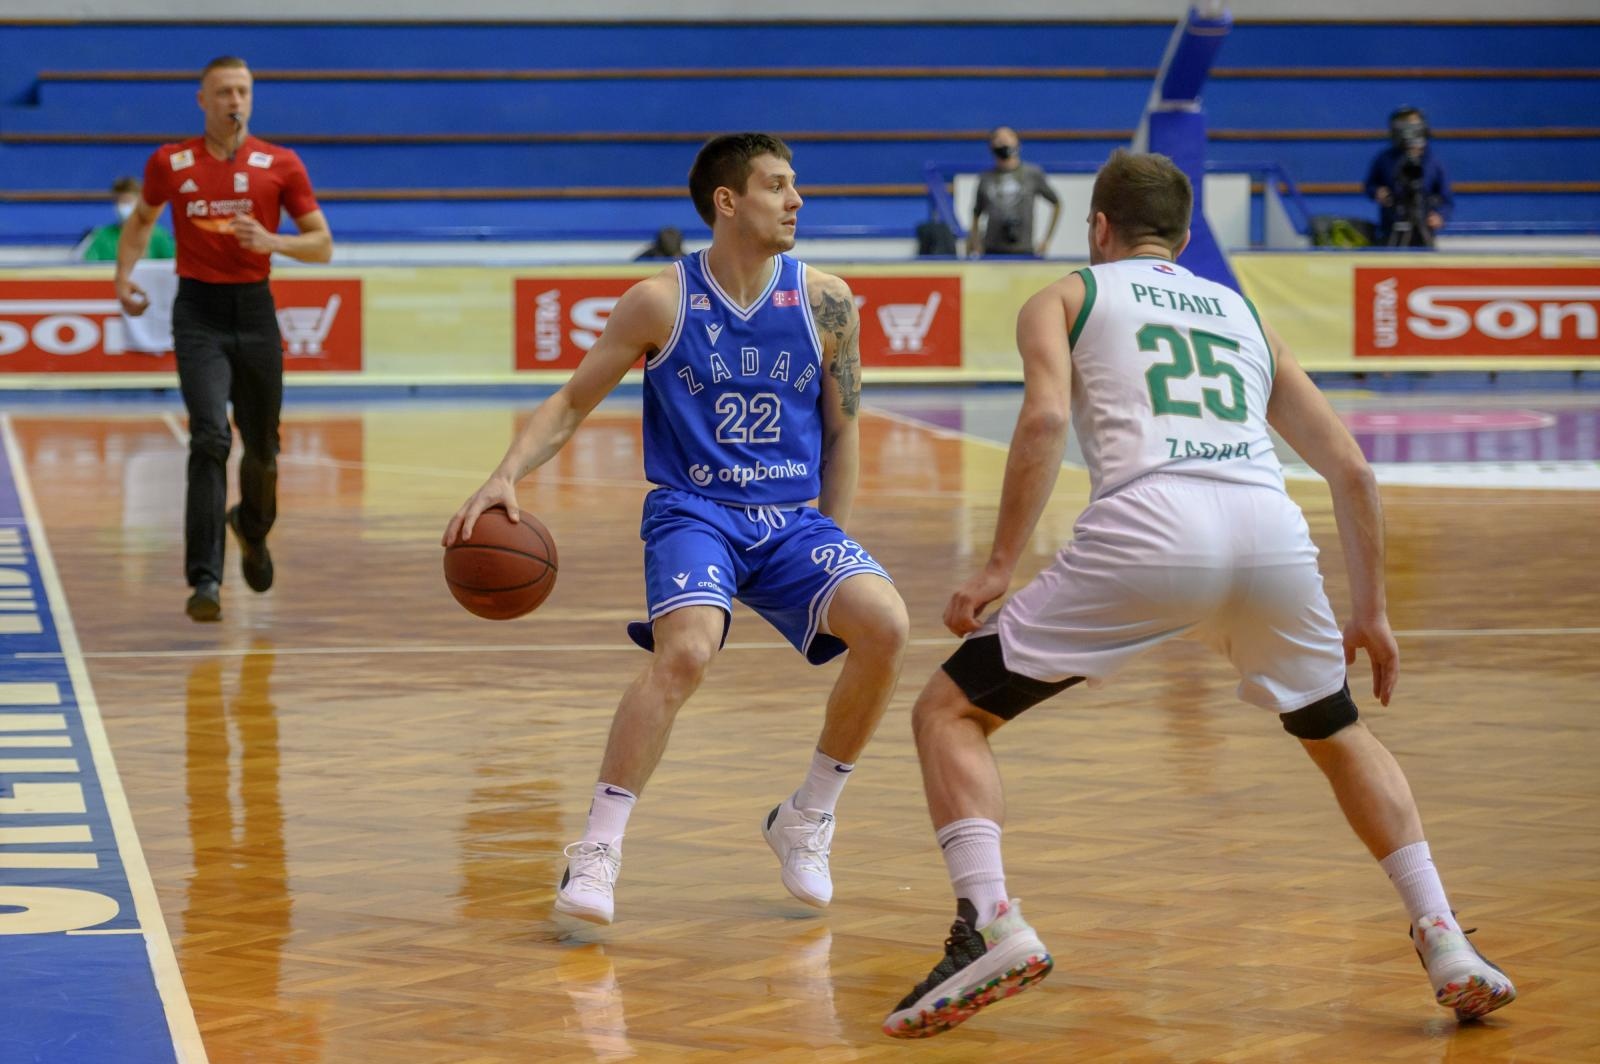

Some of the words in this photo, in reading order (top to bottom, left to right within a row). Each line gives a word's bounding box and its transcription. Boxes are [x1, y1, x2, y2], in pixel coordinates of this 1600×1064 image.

[1131, 282, 1227, 317] PETANI
[1374, 276, 1398, 348] ULTRA
[677, 347, 816, 396] ZADAR
[1136, 323, 1248, 424] 25
[715, 392, 781, 444] 22
[718, 459, 808, 487] otpbanka
[811, 539, 882, 576] 22
